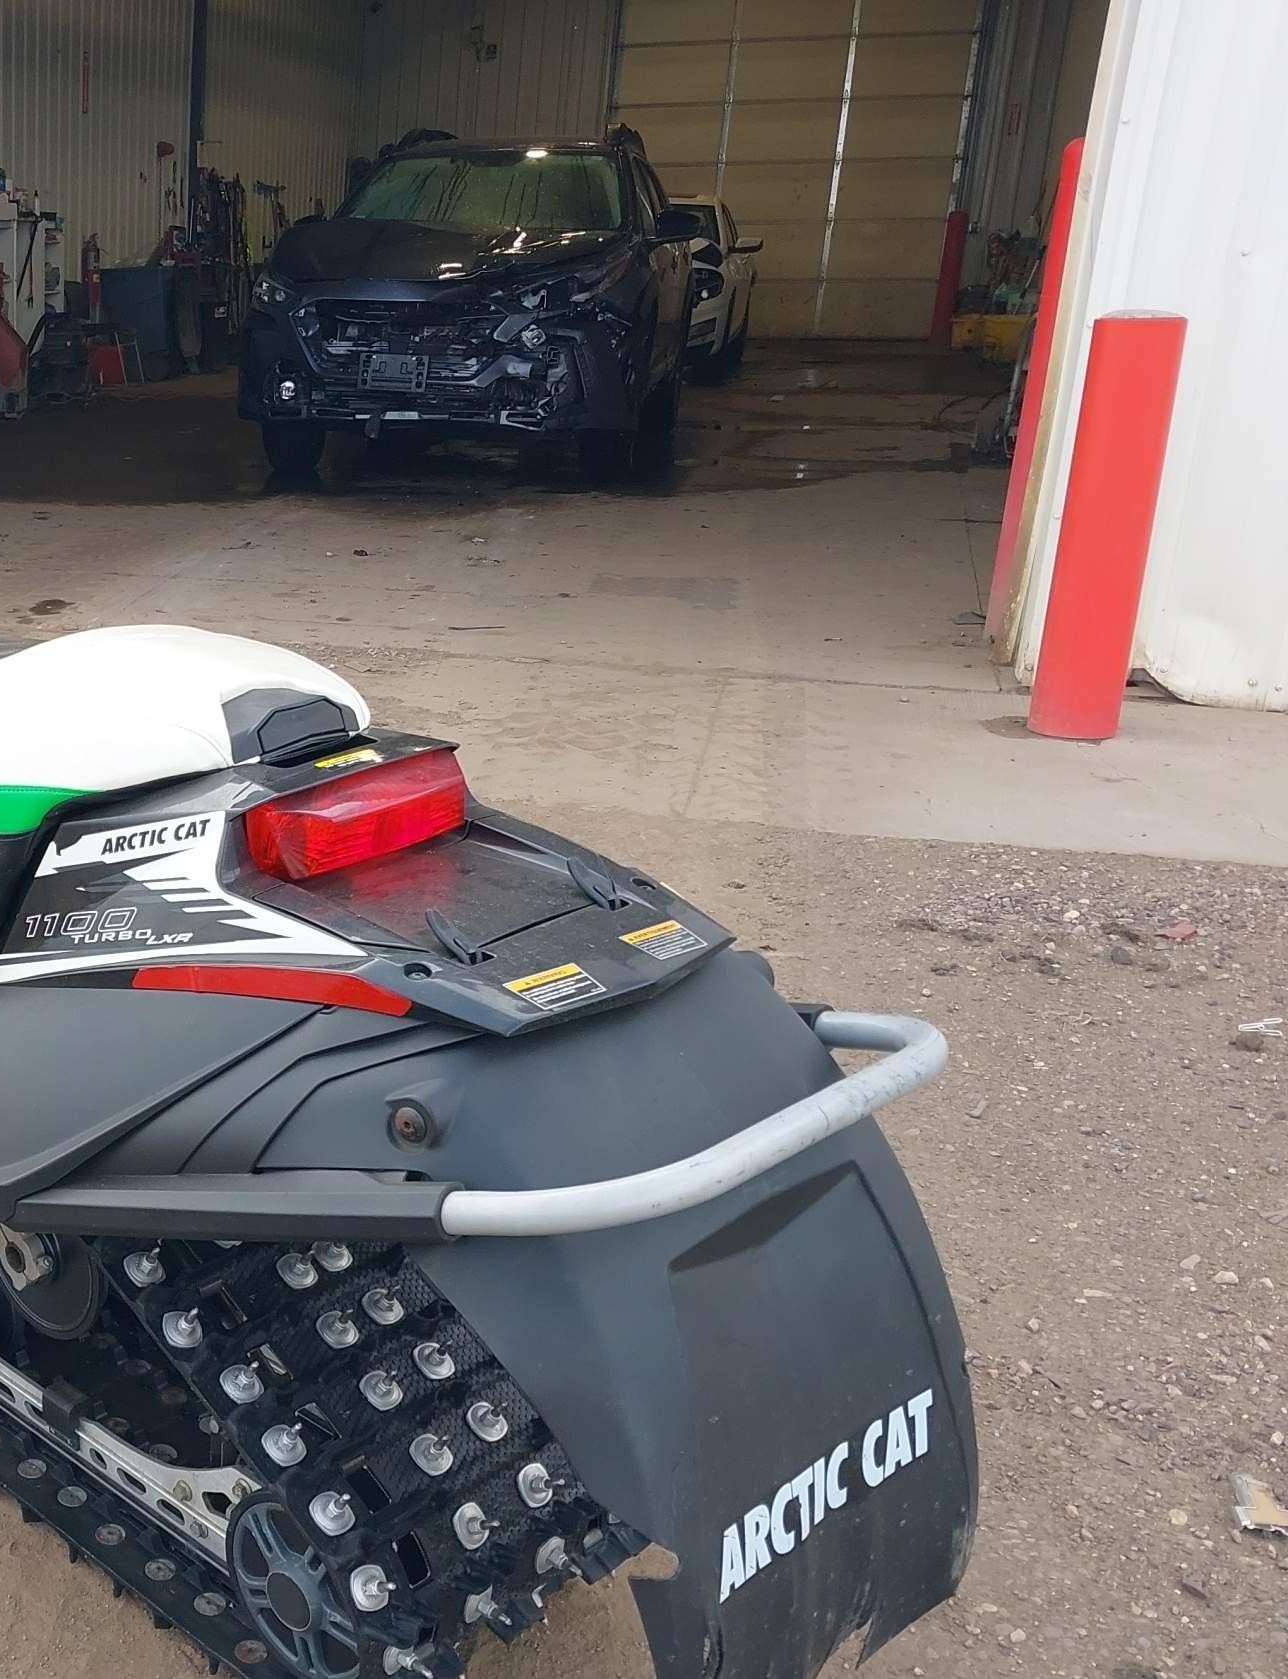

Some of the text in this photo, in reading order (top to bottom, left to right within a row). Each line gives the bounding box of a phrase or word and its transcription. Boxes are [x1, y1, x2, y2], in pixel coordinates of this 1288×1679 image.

[101, 818, 211, 856] ARCTIC CAT
[25, 907, 137, 938] 1100
[71, 929, 193, 945] TURBO LXR
[720, 1388, 933, 1604] ARCTIC CAT
